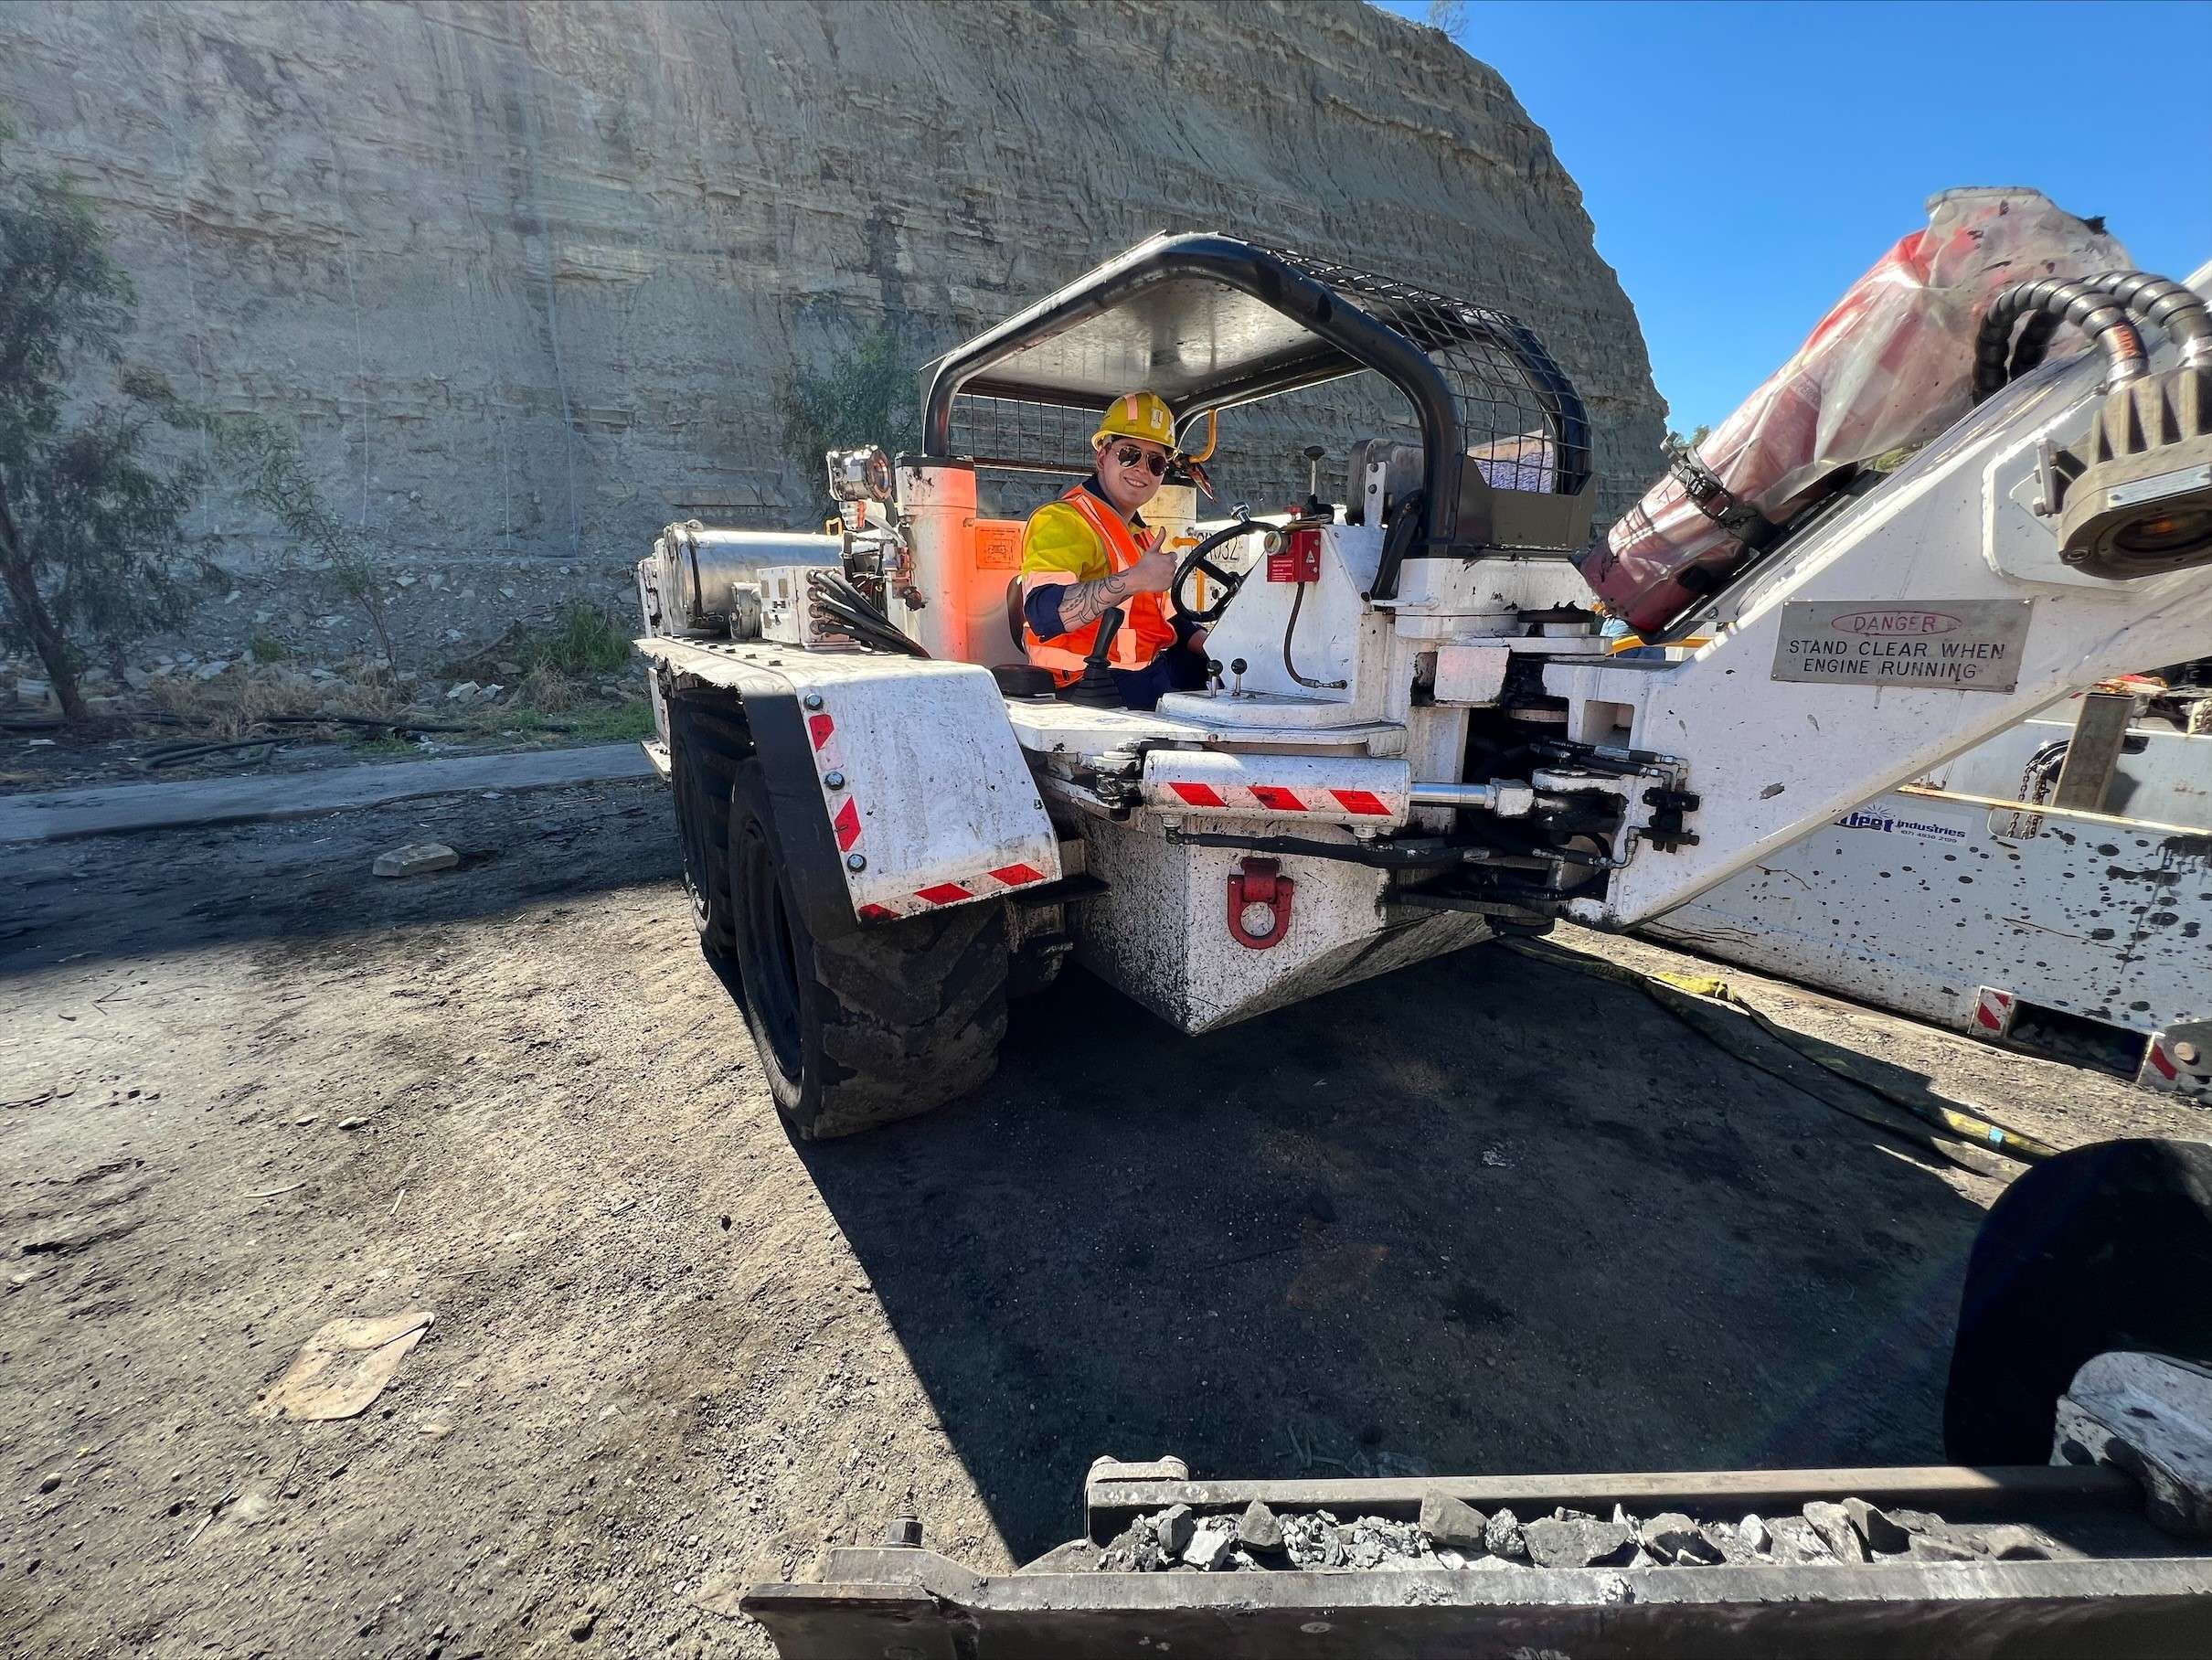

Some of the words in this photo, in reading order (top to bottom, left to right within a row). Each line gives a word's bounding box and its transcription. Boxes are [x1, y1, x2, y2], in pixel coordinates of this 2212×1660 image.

[1853, 615, 1937, 632] DANGER
[1788, 640, 1847, 656] STAND
[1858, 641, 1928, 657] CLEAR
[1941, 643, 2005, 659] WHEN
[1803, 658, 1870, 675] ENGINE
[1880, 660, 1977, 678] RUNNING
